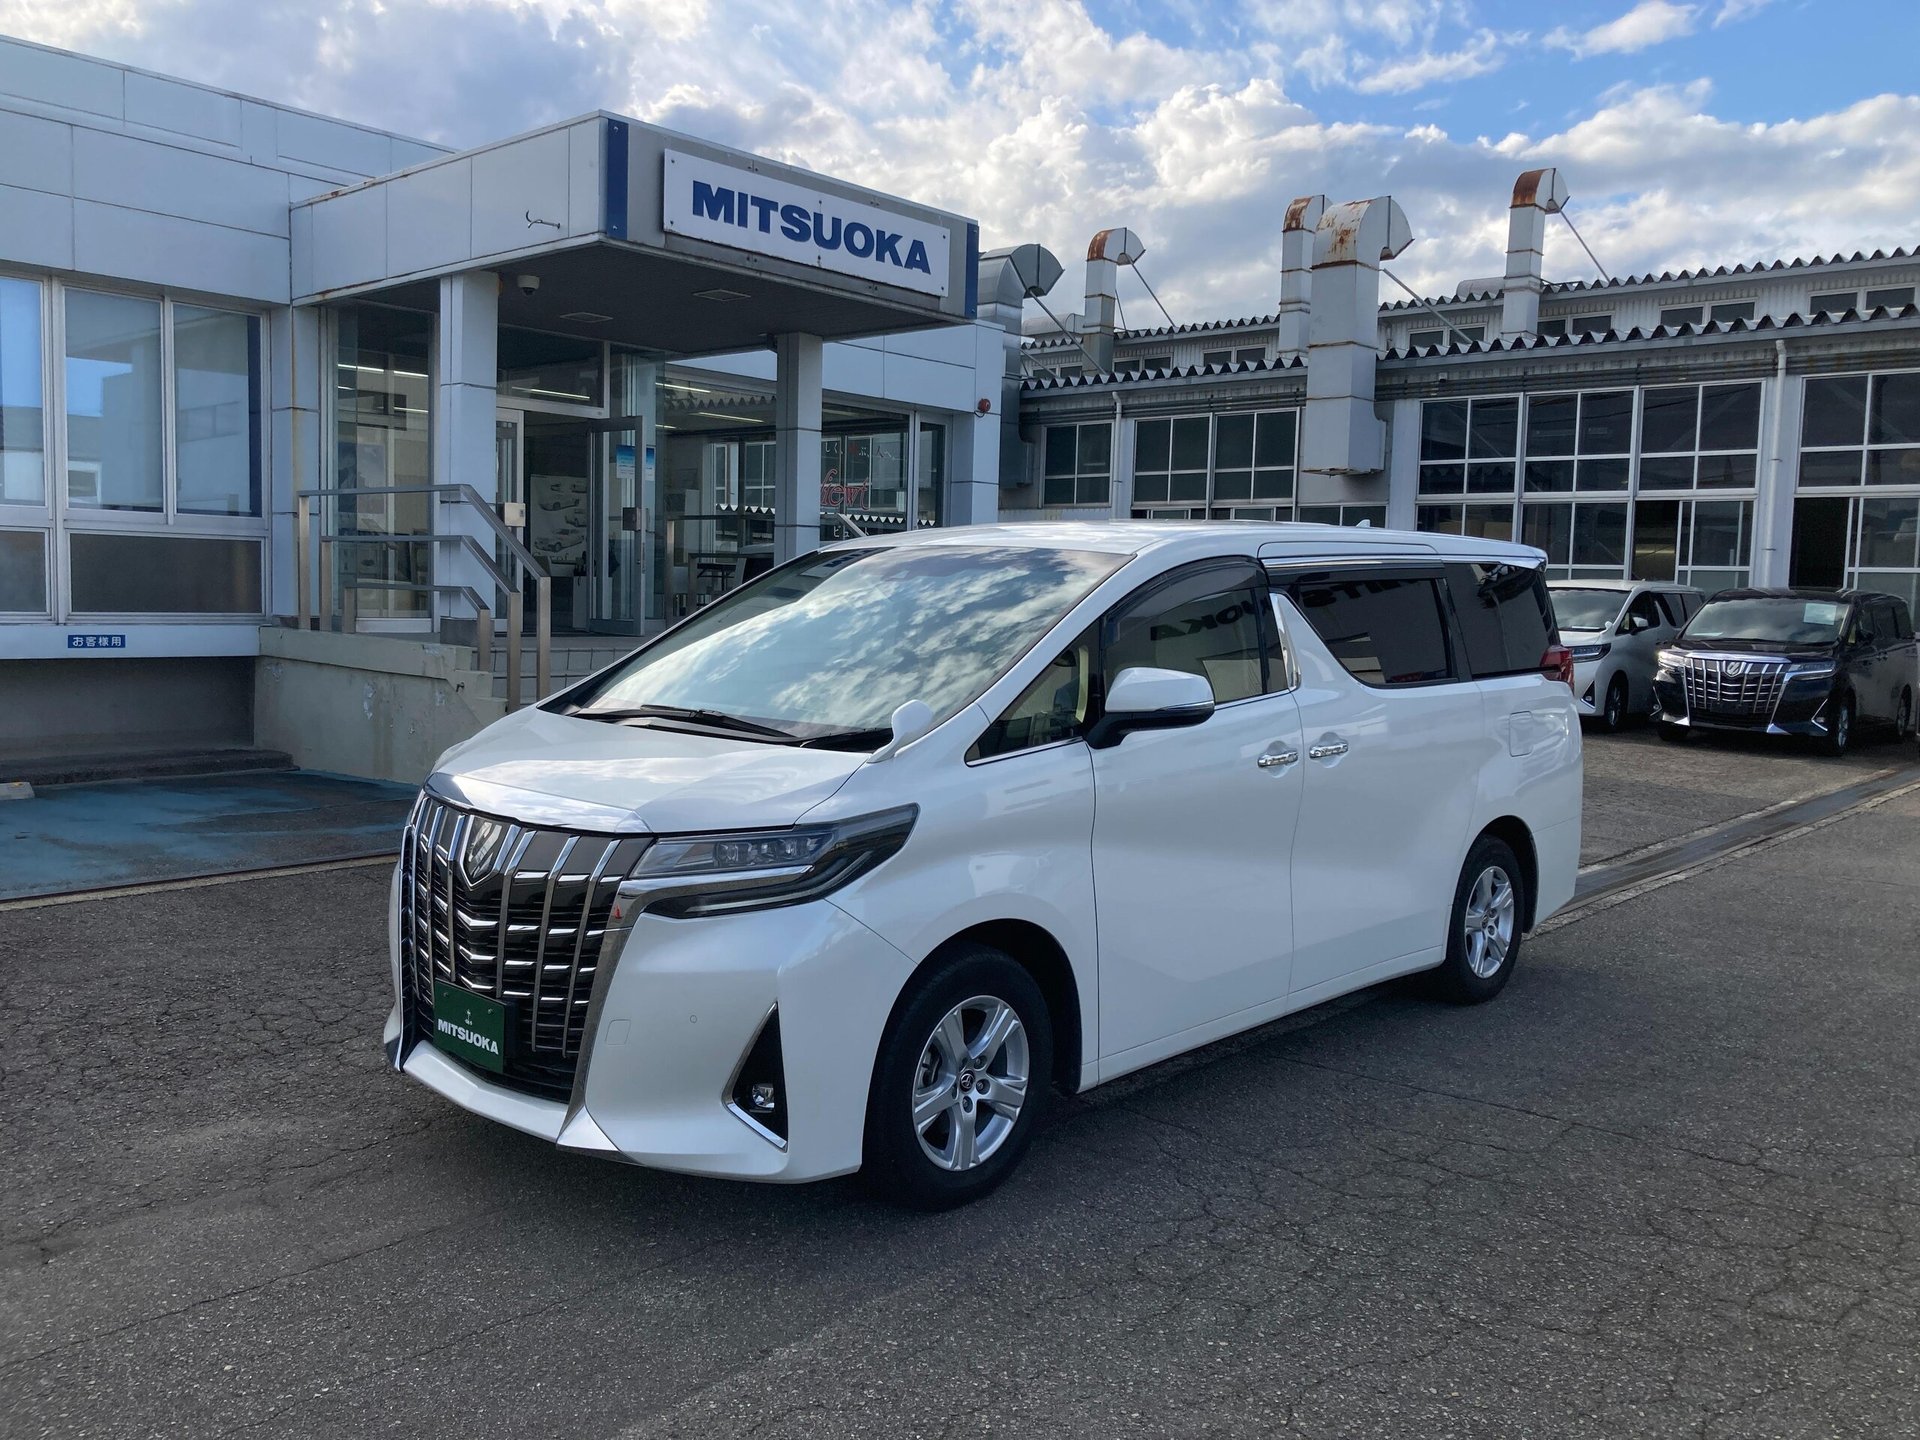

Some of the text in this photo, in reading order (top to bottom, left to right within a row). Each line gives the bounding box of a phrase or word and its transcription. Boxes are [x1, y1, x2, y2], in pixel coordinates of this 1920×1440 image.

[692, 180, 931, 275] MITSUOKA
[72, 636, 122, 647] お客様用
[437, 1018, 499, 1055] MITSUOKA
